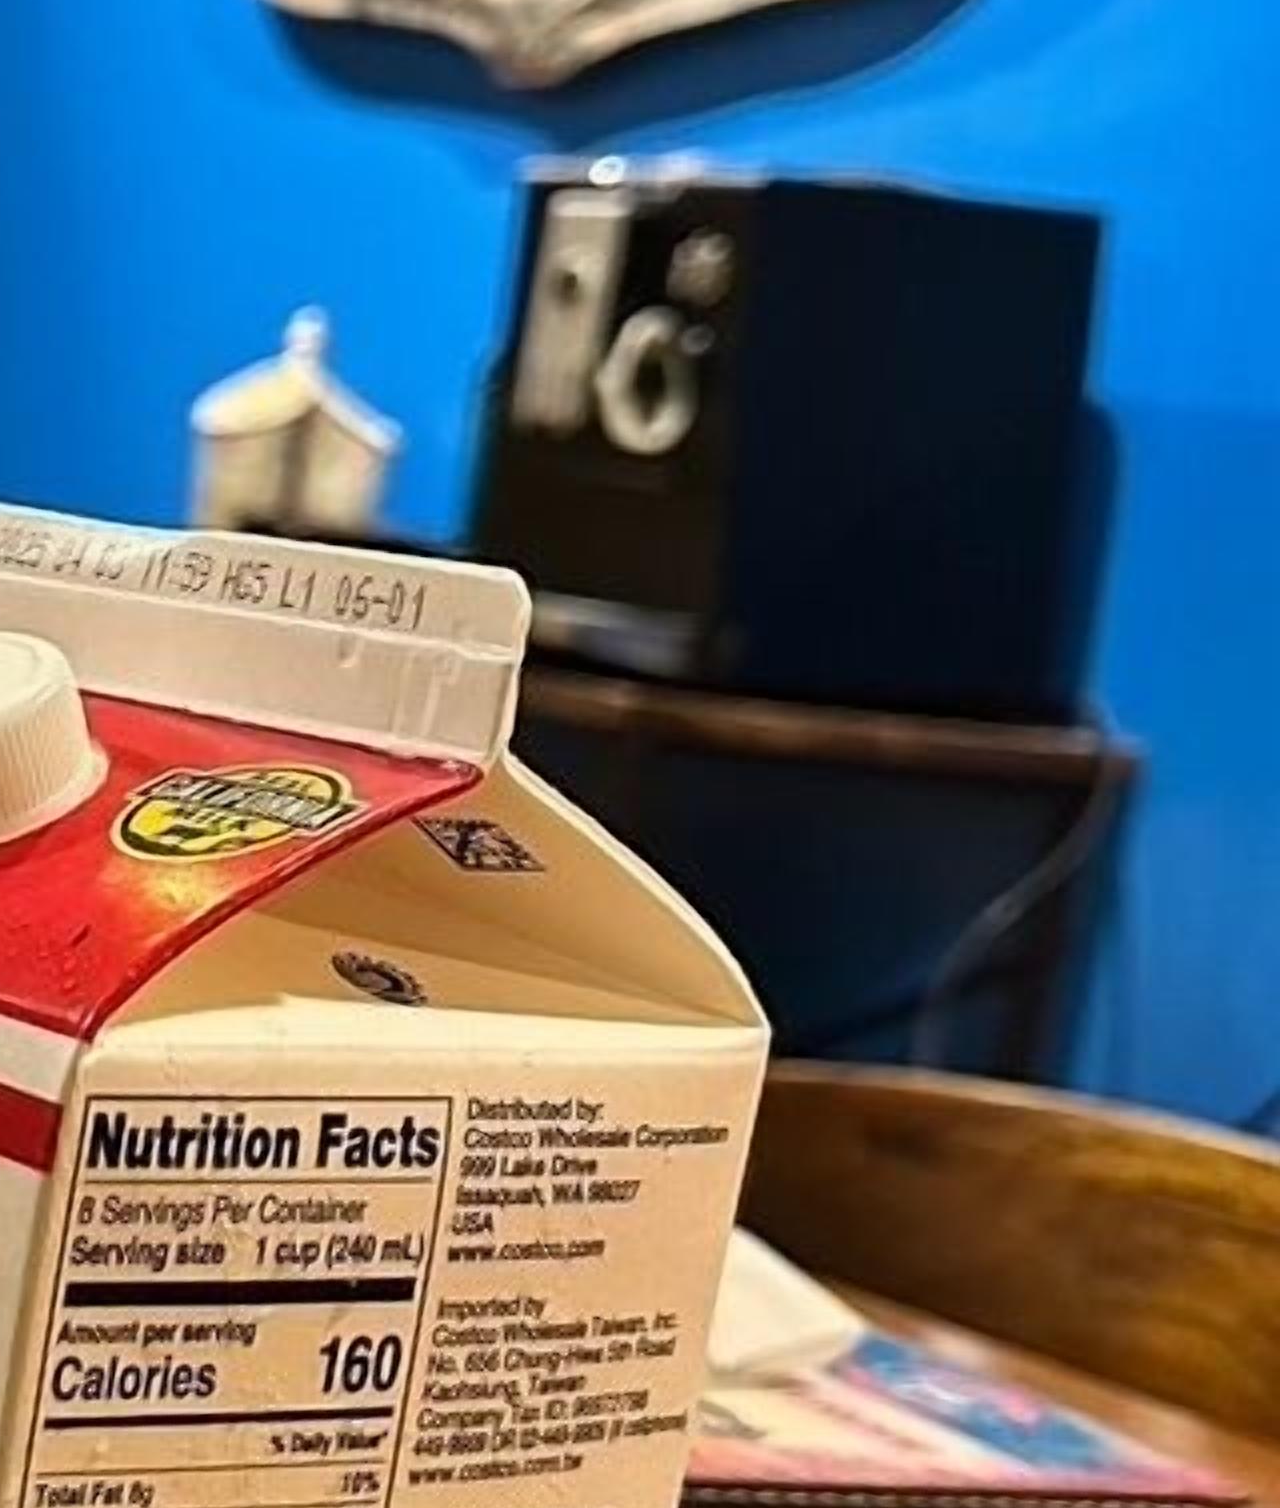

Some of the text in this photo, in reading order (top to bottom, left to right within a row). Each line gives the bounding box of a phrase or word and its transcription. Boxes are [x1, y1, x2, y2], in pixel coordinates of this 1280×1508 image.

[468, 1097, 573, 1120] Distributed
[88, 1112, 440, 1170] Nutrition Facts
[465, 1128, 532, 1148] Costco
[539, 1126, 632, 1147] Wholesale
[100, 1196, 204, 1232] Servings
[213, 1196, 251, 1225] Per
[258, 1193, 367, 1224] Container
[452, 1212, 493, 1235] USA
[70, 1236, 170, 1271] Serving
[175, 1239, 226, 1264] size
[275, 1243, 320, 1270] cup
[380, 1233, 424, 1266] mL)
[56, 1321, 257, 1348] Amount per serving
[52, 1334, 403, 1401] Calories 160
[35, 1483, 85, 1508] Total
[90, 1482, 124, 1506] Fat
